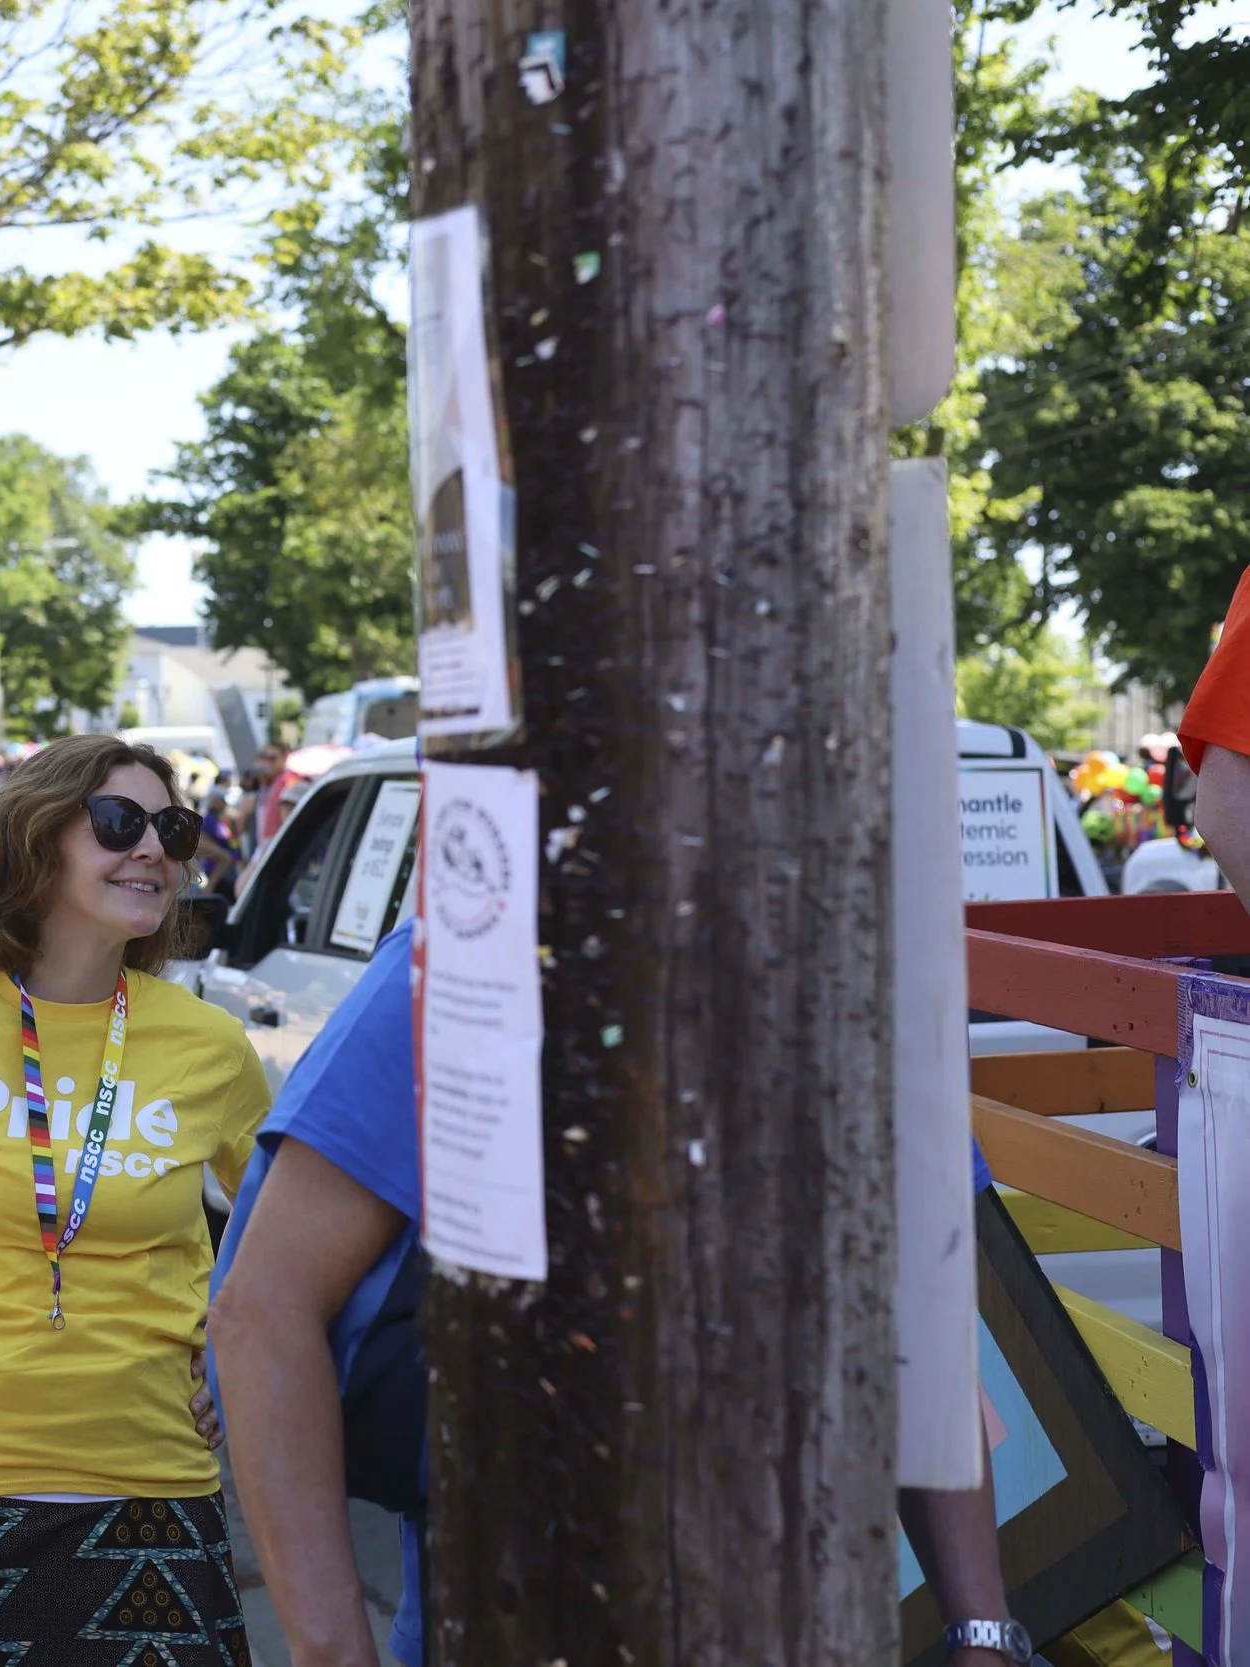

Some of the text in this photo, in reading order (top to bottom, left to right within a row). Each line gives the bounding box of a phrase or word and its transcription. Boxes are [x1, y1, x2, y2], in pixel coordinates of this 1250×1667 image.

[963, 844, 1028, 867] ession
[110, 991, 126, 1046] nscc
[96, 1060, 118, 1116] nscc
[79, 1129, 104, 1184] nscc
